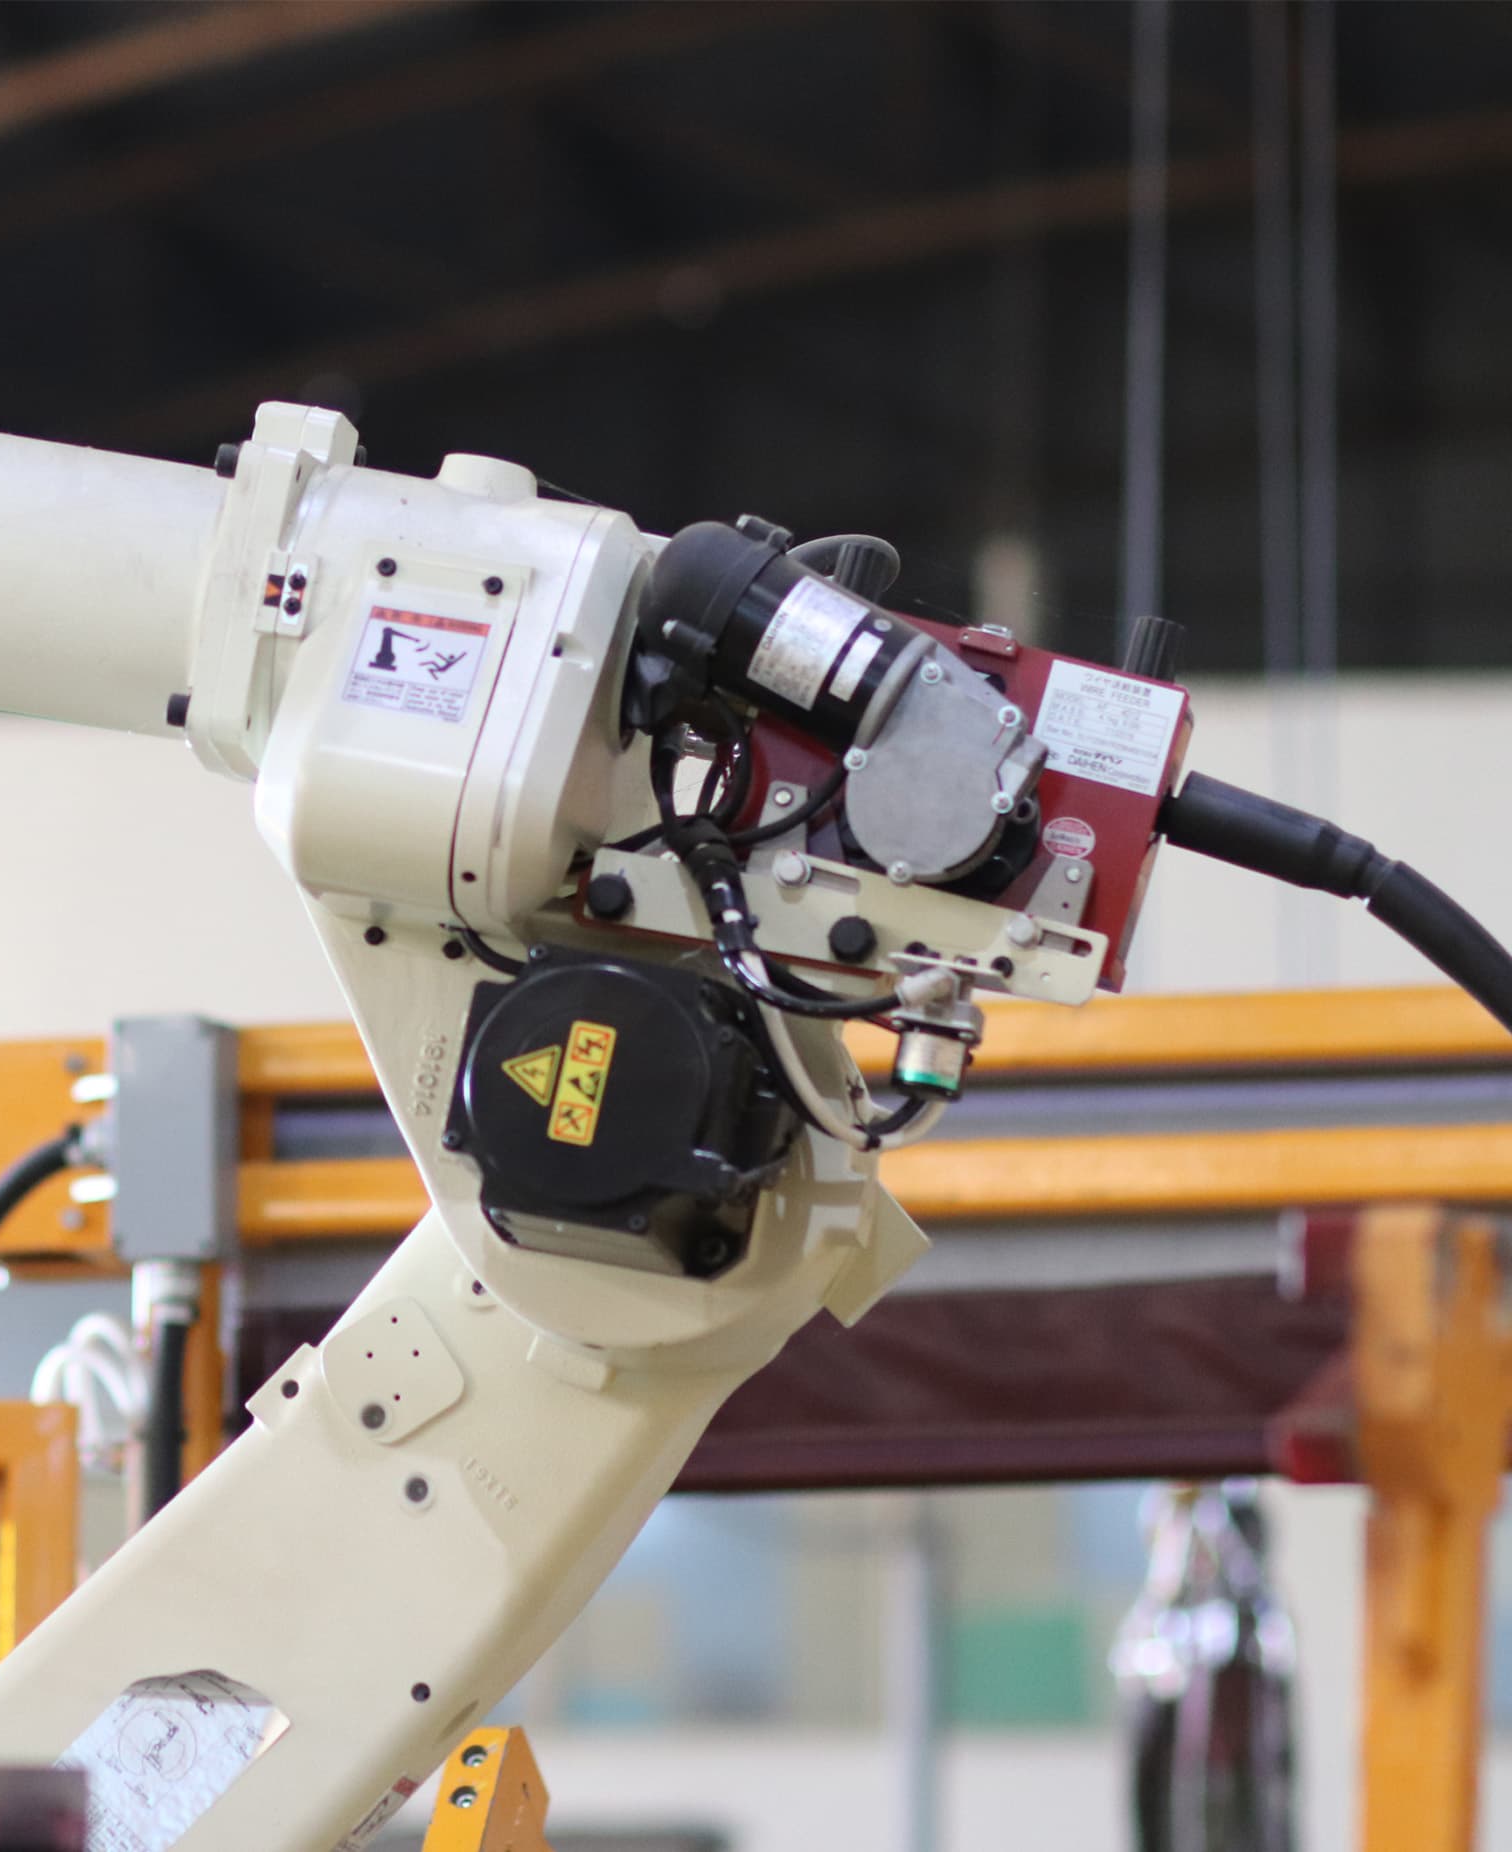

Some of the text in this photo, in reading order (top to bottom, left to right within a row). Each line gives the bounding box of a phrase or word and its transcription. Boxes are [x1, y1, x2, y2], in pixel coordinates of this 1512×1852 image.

[1080, 683, 1151, 708] WIRE FEEDER
[1068, 755, 1107, 772] DAIHEN
